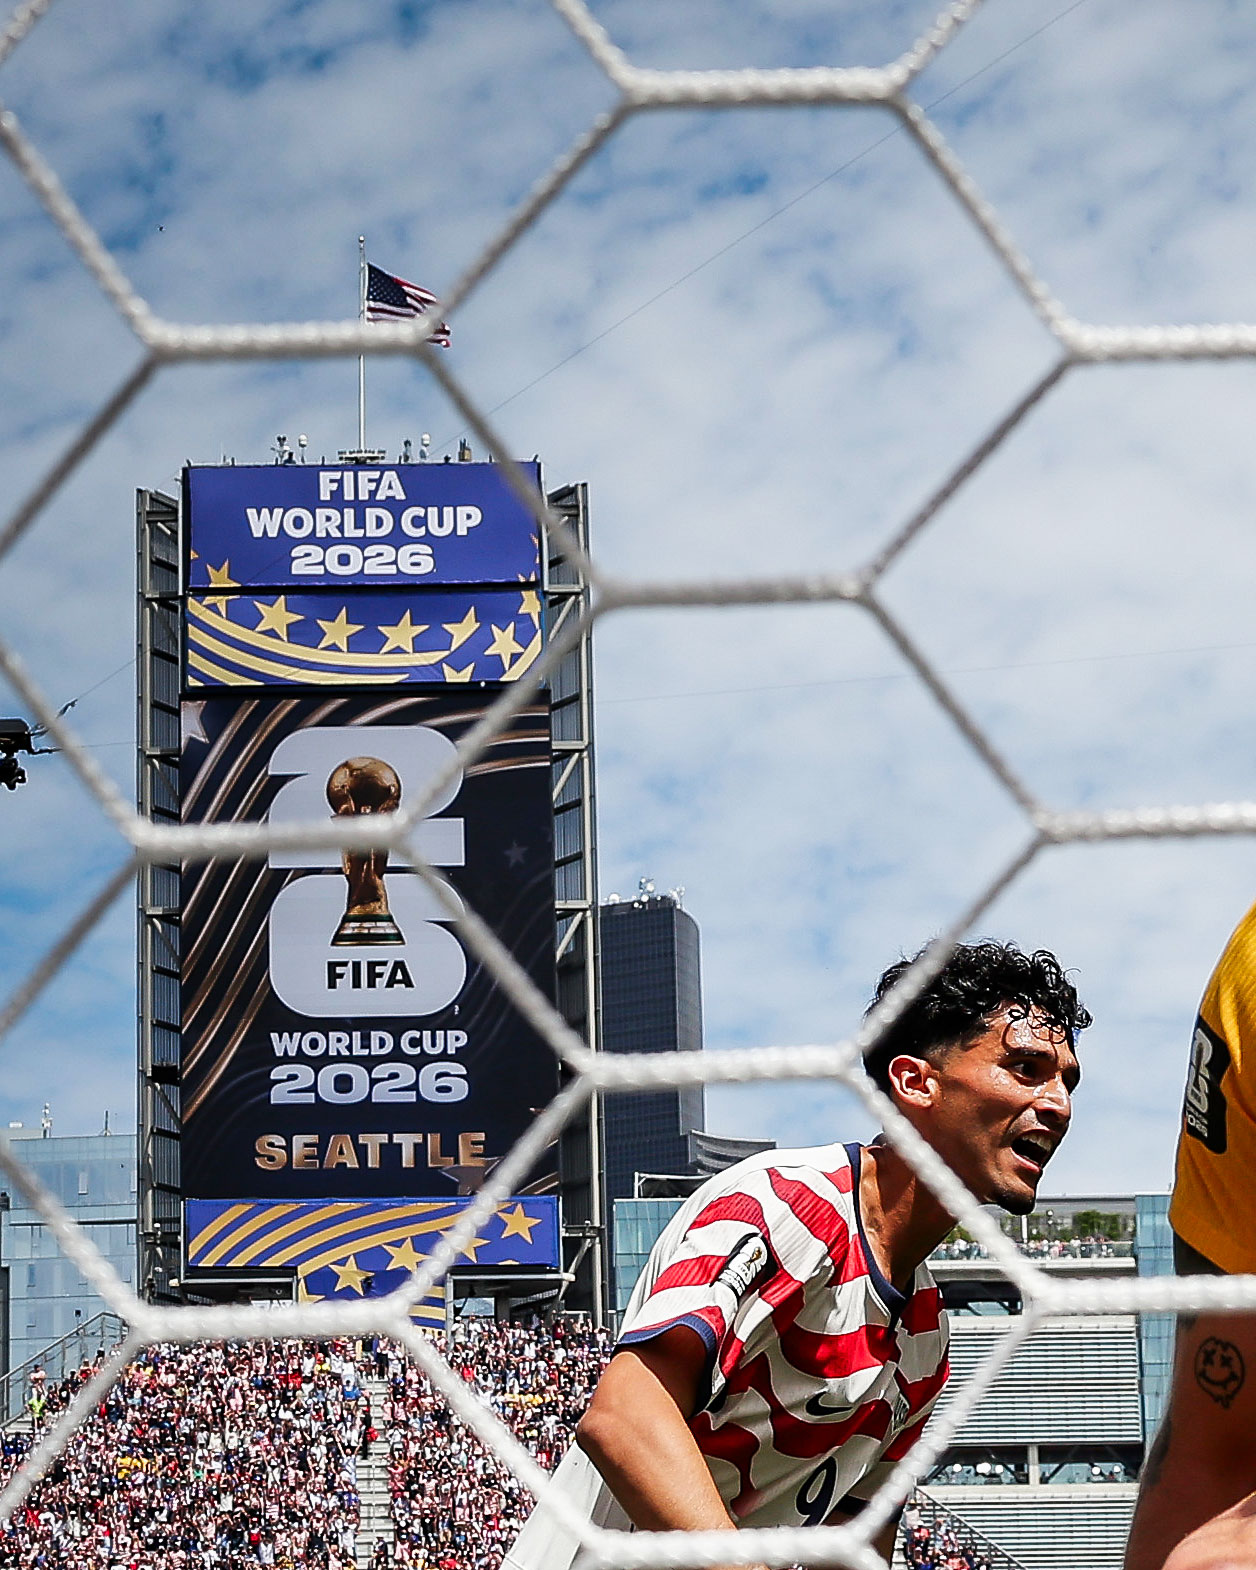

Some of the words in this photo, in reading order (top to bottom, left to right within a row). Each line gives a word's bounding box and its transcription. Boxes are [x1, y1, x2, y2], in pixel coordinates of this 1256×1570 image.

[319, 470, 406, 501] FIFA
[246, 507, 394, 538] WORLD
[401, 505, 483, 537] CUP
[291, 544, 435, 575] 2026
[327, 960, 415, 990] FIFA
[270, 1031, 394, 1057] WORLD
[400, 1030, 469, 1055] CUP
[270, 1062, 470, 1105] 2026
[255, 1131, 487, 1171] SEATTLE
[796, 1455, 838, 1529] 9
